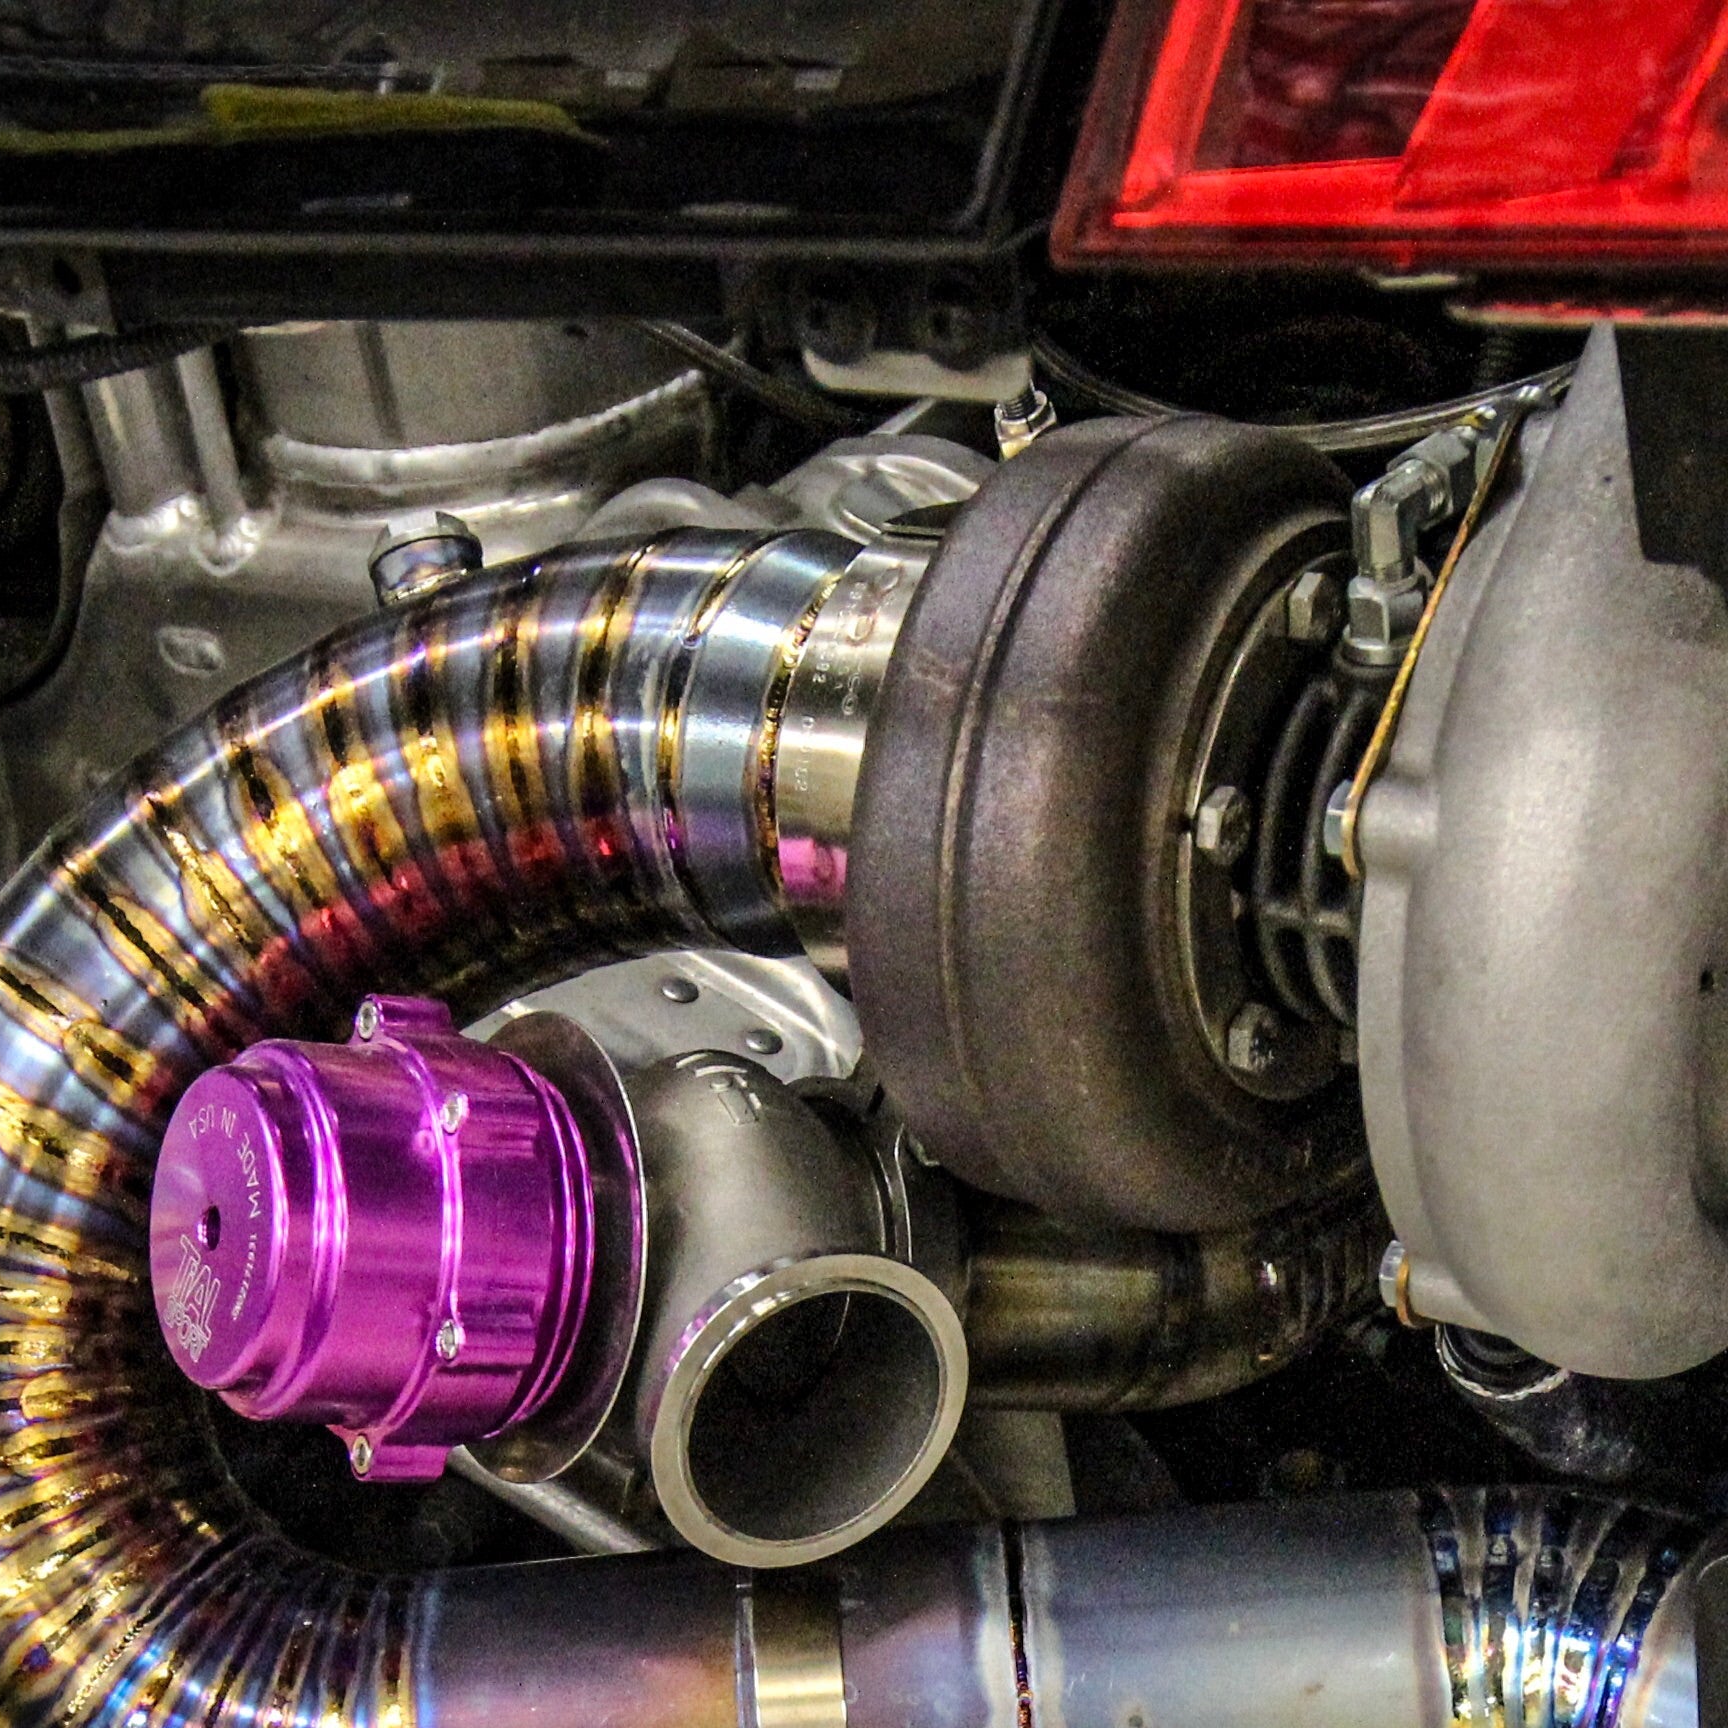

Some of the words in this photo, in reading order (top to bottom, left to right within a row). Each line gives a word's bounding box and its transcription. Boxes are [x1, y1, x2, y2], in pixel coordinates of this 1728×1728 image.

[188, 1104, 215, 1141] USA
[220, 1106, 237, 1140] IN
[236, 1131, 262, 1220] MADE
[162, 1295, 208, 1363] SPORT
